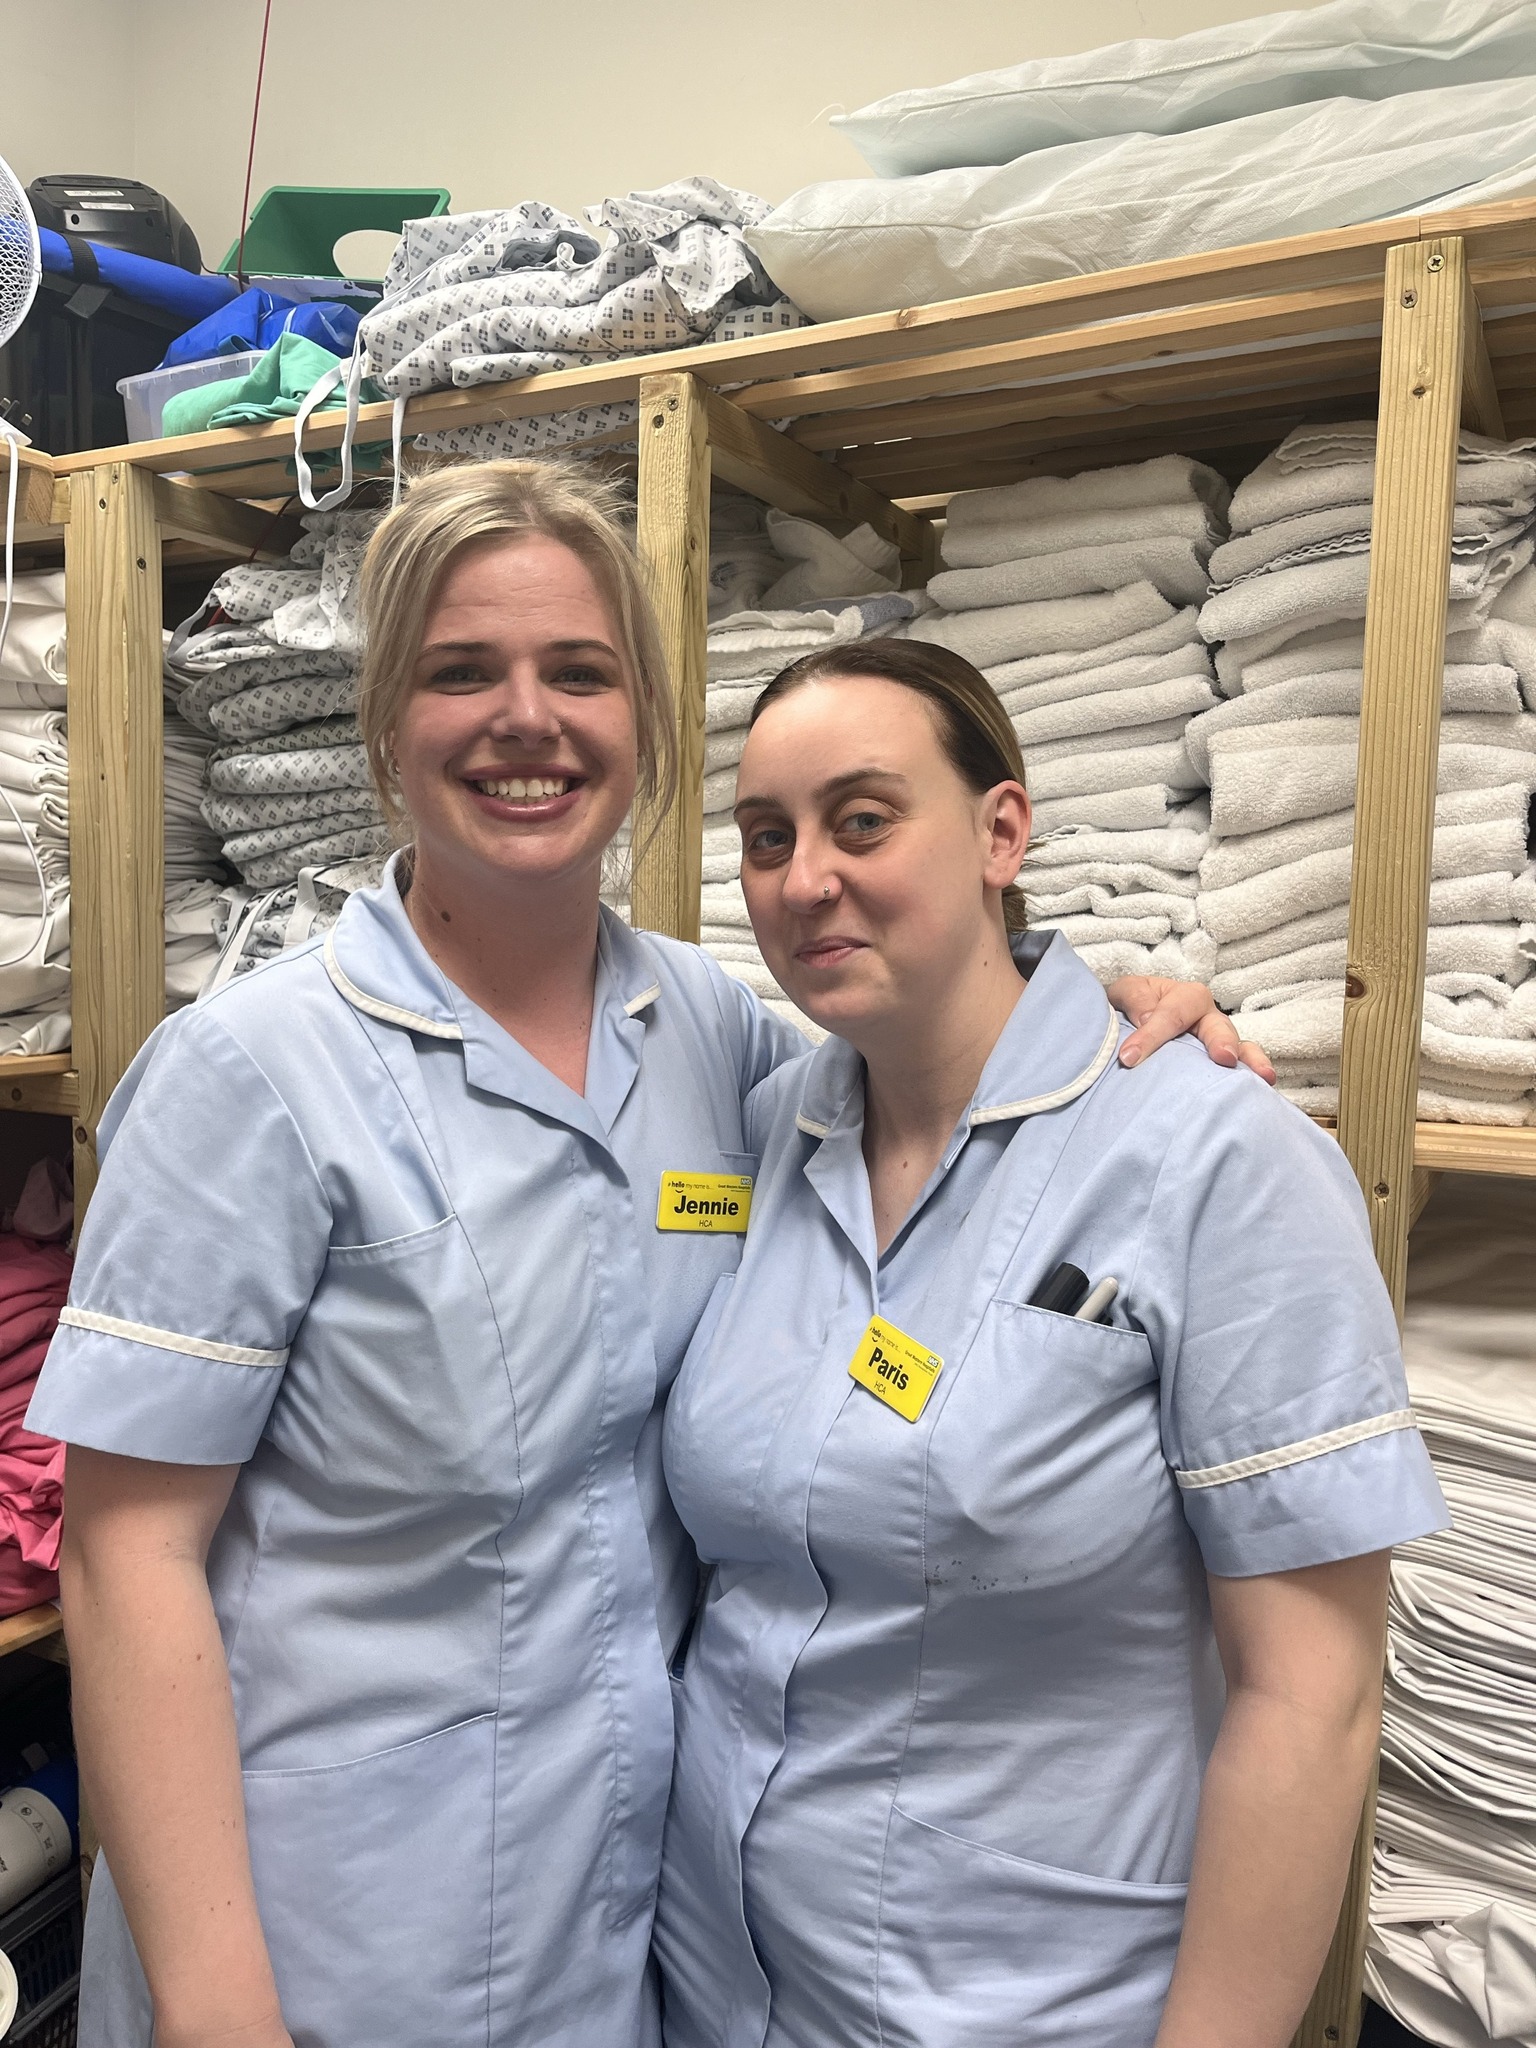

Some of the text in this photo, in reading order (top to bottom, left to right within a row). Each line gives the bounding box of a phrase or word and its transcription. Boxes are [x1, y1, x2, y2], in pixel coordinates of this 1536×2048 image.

[674, 1195, 739, 1216] Jennie
[868, 1347, 909, 1391] Paris
[928, 1355, 939, 1368] NHS
[873, 1380, 887, 1395] HCA
